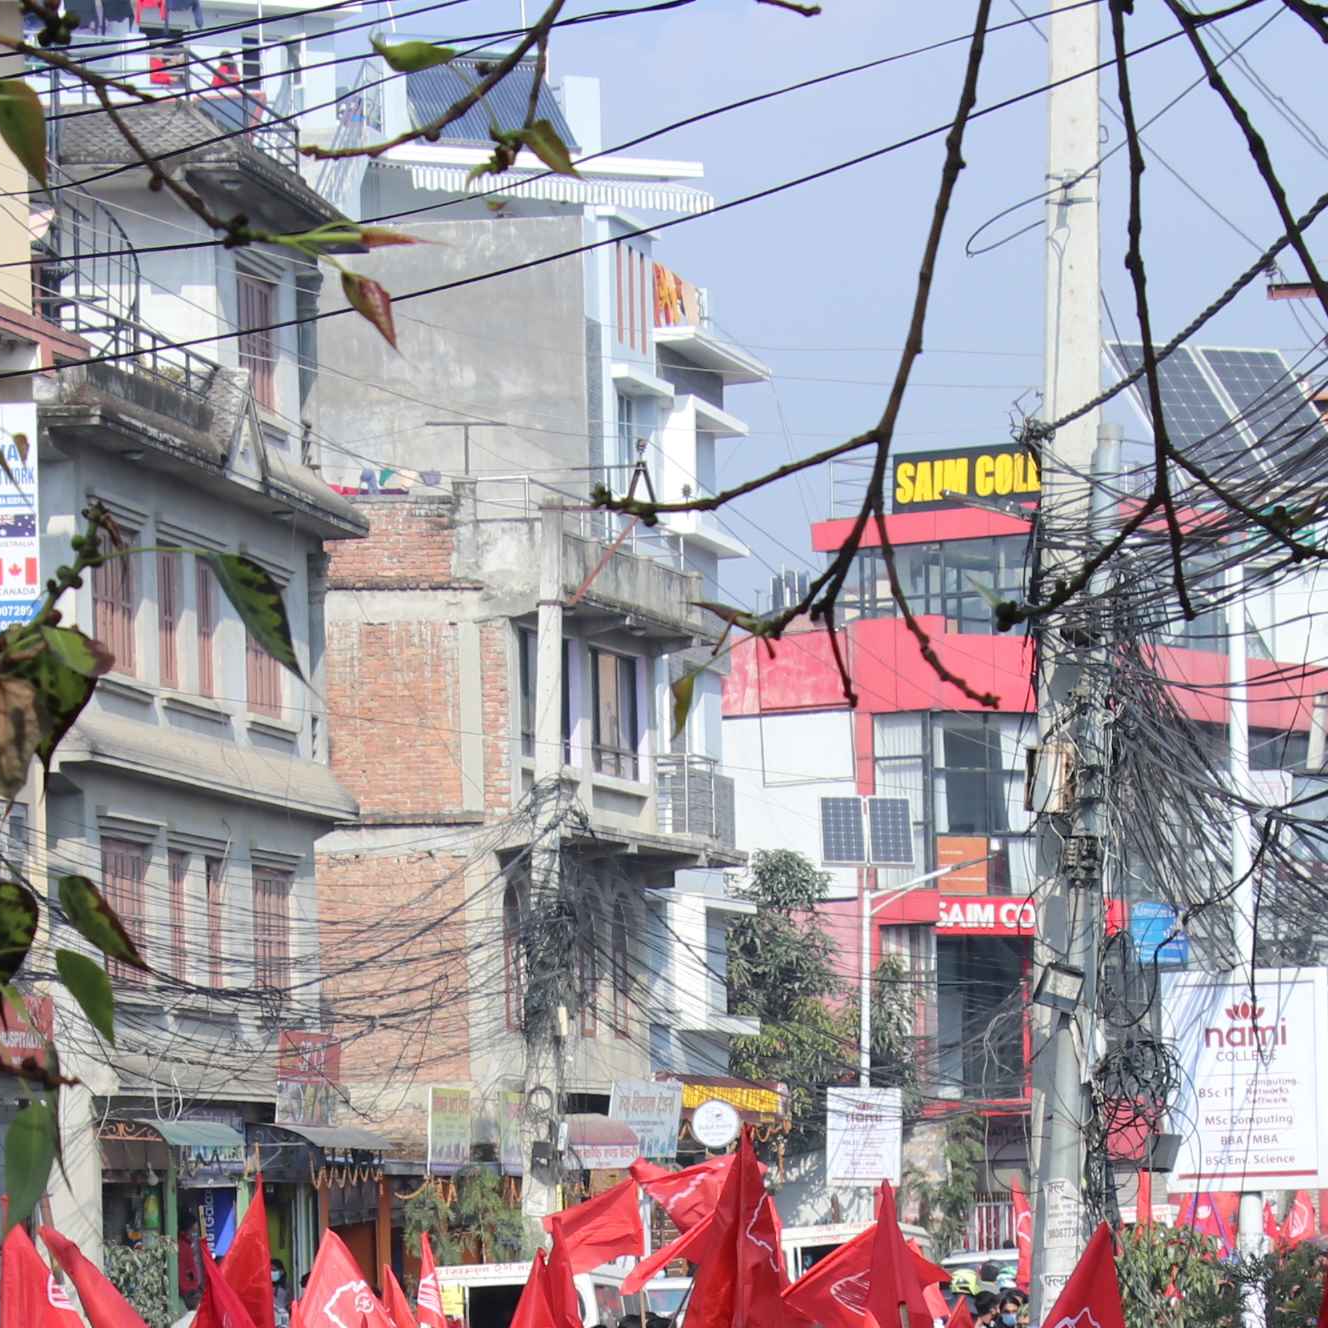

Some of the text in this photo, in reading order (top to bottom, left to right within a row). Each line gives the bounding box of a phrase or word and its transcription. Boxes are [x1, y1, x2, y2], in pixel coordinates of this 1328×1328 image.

[895, 457, 969, 504] SAIM
[1204, 1017, 1287, 1049] nami
[1215, 1050, 1276, 1063] COLLEGE
[1198, 1088, 1222, 1098] BSc
[1204, 1114, 1294, 1127] MSc Computing
[1220, 1134, 1280, 1145] BBA MBA
[1253, 1153, 1296, 1165] Science
